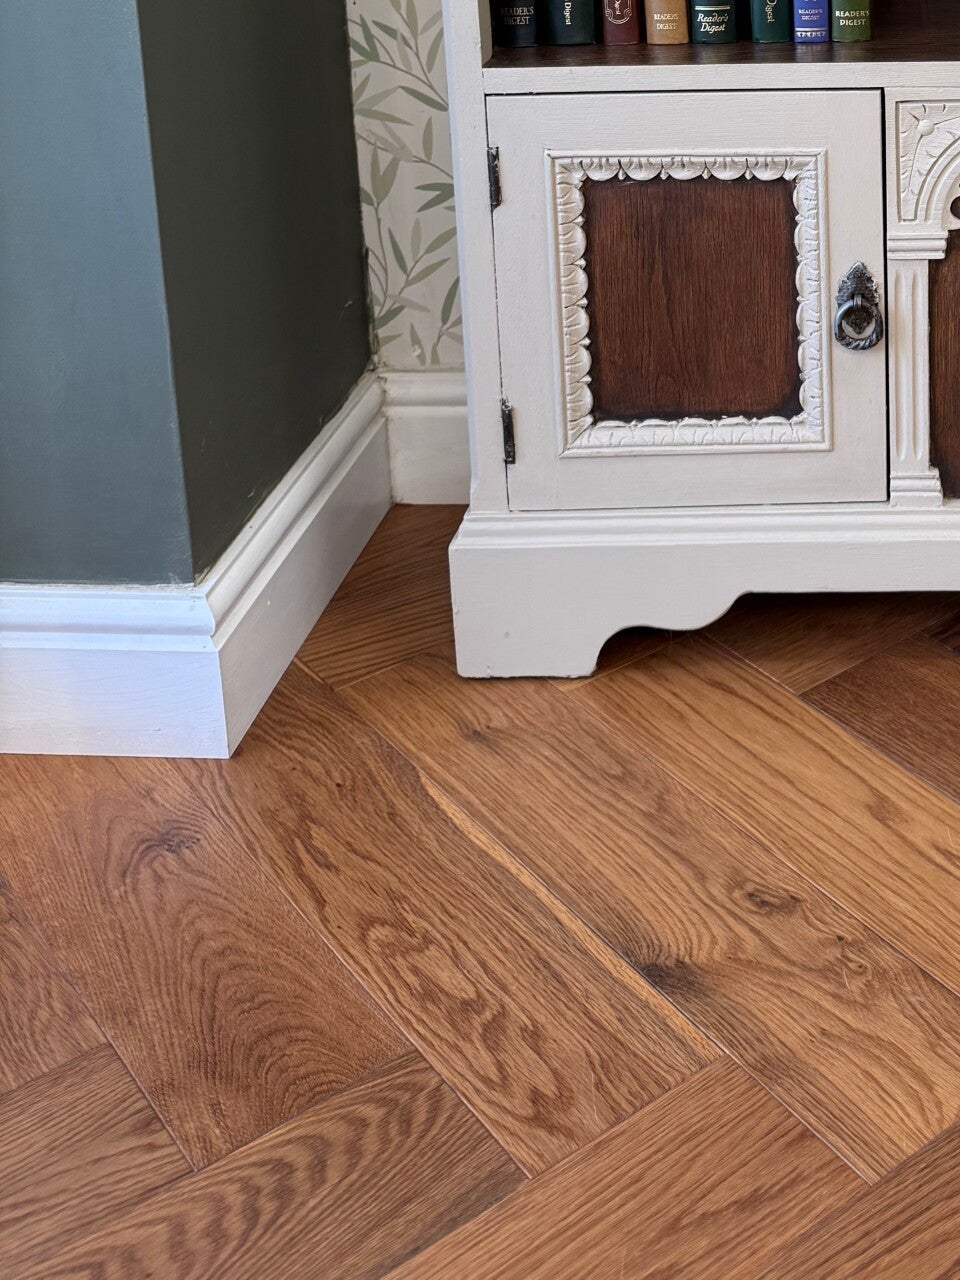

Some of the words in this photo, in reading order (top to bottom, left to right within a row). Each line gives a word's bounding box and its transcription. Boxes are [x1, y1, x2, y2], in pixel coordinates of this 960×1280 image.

[563, 2, 572, 25] Digest
[697, 12, 729, 23] Reader's
[835, 10, 870, 18] READER'S
[700, 22, 726, 34] Digest
